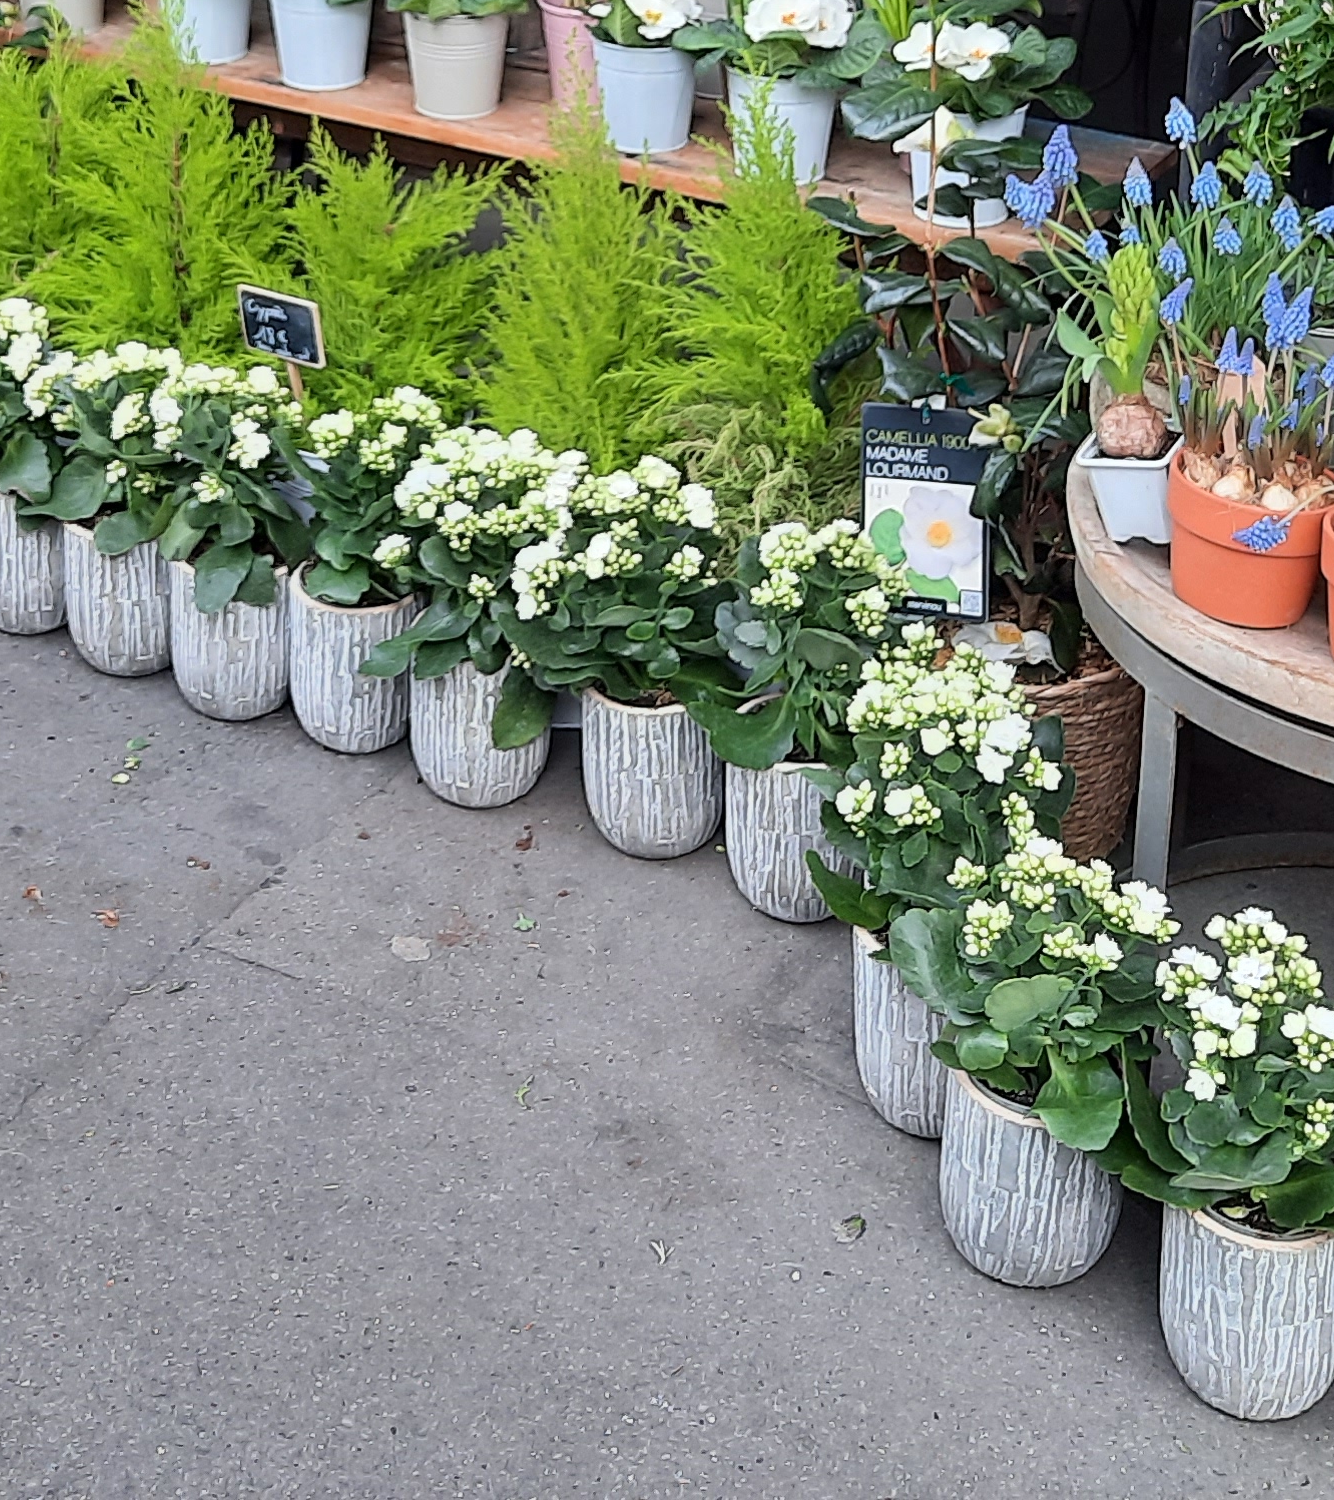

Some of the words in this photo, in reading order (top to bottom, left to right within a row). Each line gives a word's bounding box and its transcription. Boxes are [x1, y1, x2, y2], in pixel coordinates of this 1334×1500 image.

[866, 428, 938, 448] CAMELLIA
[866, 446, 929, 465] MADAME
[866, 462, 950, 482] LOURMAND
